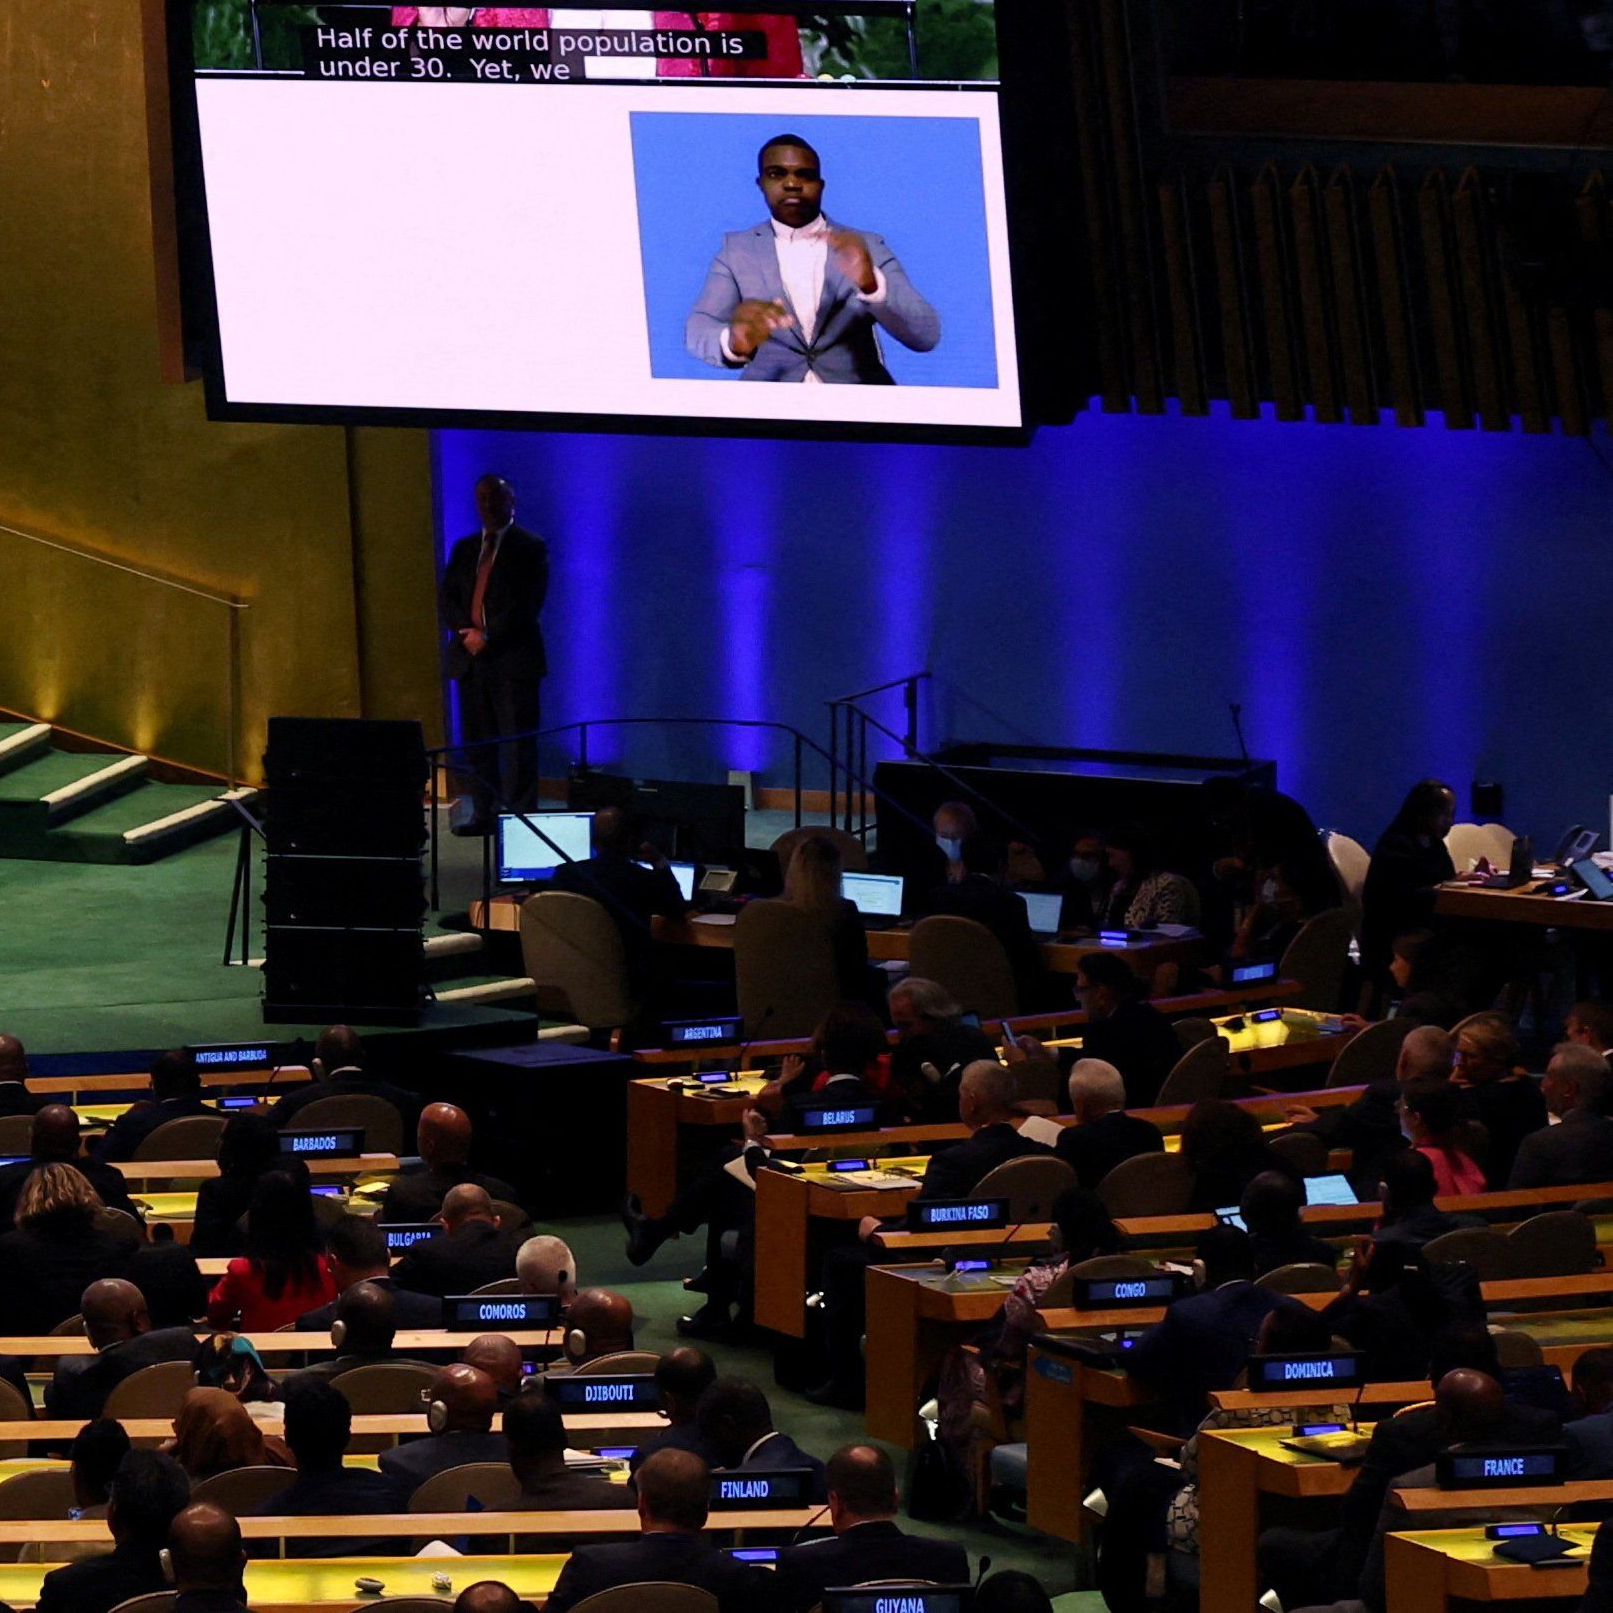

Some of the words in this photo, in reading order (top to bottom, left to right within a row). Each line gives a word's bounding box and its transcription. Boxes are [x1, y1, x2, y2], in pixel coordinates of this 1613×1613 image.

[317, 28, 373, 50] Half
[382, 29, 410, 50] of
[416, 29, 462, 51] the
[471, 30, 549, 52] world
[559, 31, 711, 57] population
[720, 33, 743, 55] is
[320, 57, 400, 79] under
[410, 58, 452, 79] 30.
[469, 58, 521, 80] Yet,
[530, 63, 571, 81] we
[684, 1026, 722, 1040] ARGENTINA
[195, 1051, 223, 1063] ANTIGUA
[224, 1051, 237, 1062] AND
[238, 1049, 267, 1062] BARBUDA
[823, 1110, 855, 1125] BELARUS
[293, 1136, 337, 1152] BARBADOS
[930, 1206, 967, 1223] BURKINA
[968, 1205, 989, 1221] FASO
[1115, 1282, 1146, 1298] CONGO
[479, 1303, 526, 1320] COMOROS
[1284, 1362, 1334, 1380] DOMINICA
[585, 1384, 634, 1402] DJIBOUTI
[1484, 1458, 1524, 1477] FRANCE
[720, 1480, 770, 1499] FINLAND
[875, 1597, 925, 1613] GUYANA
